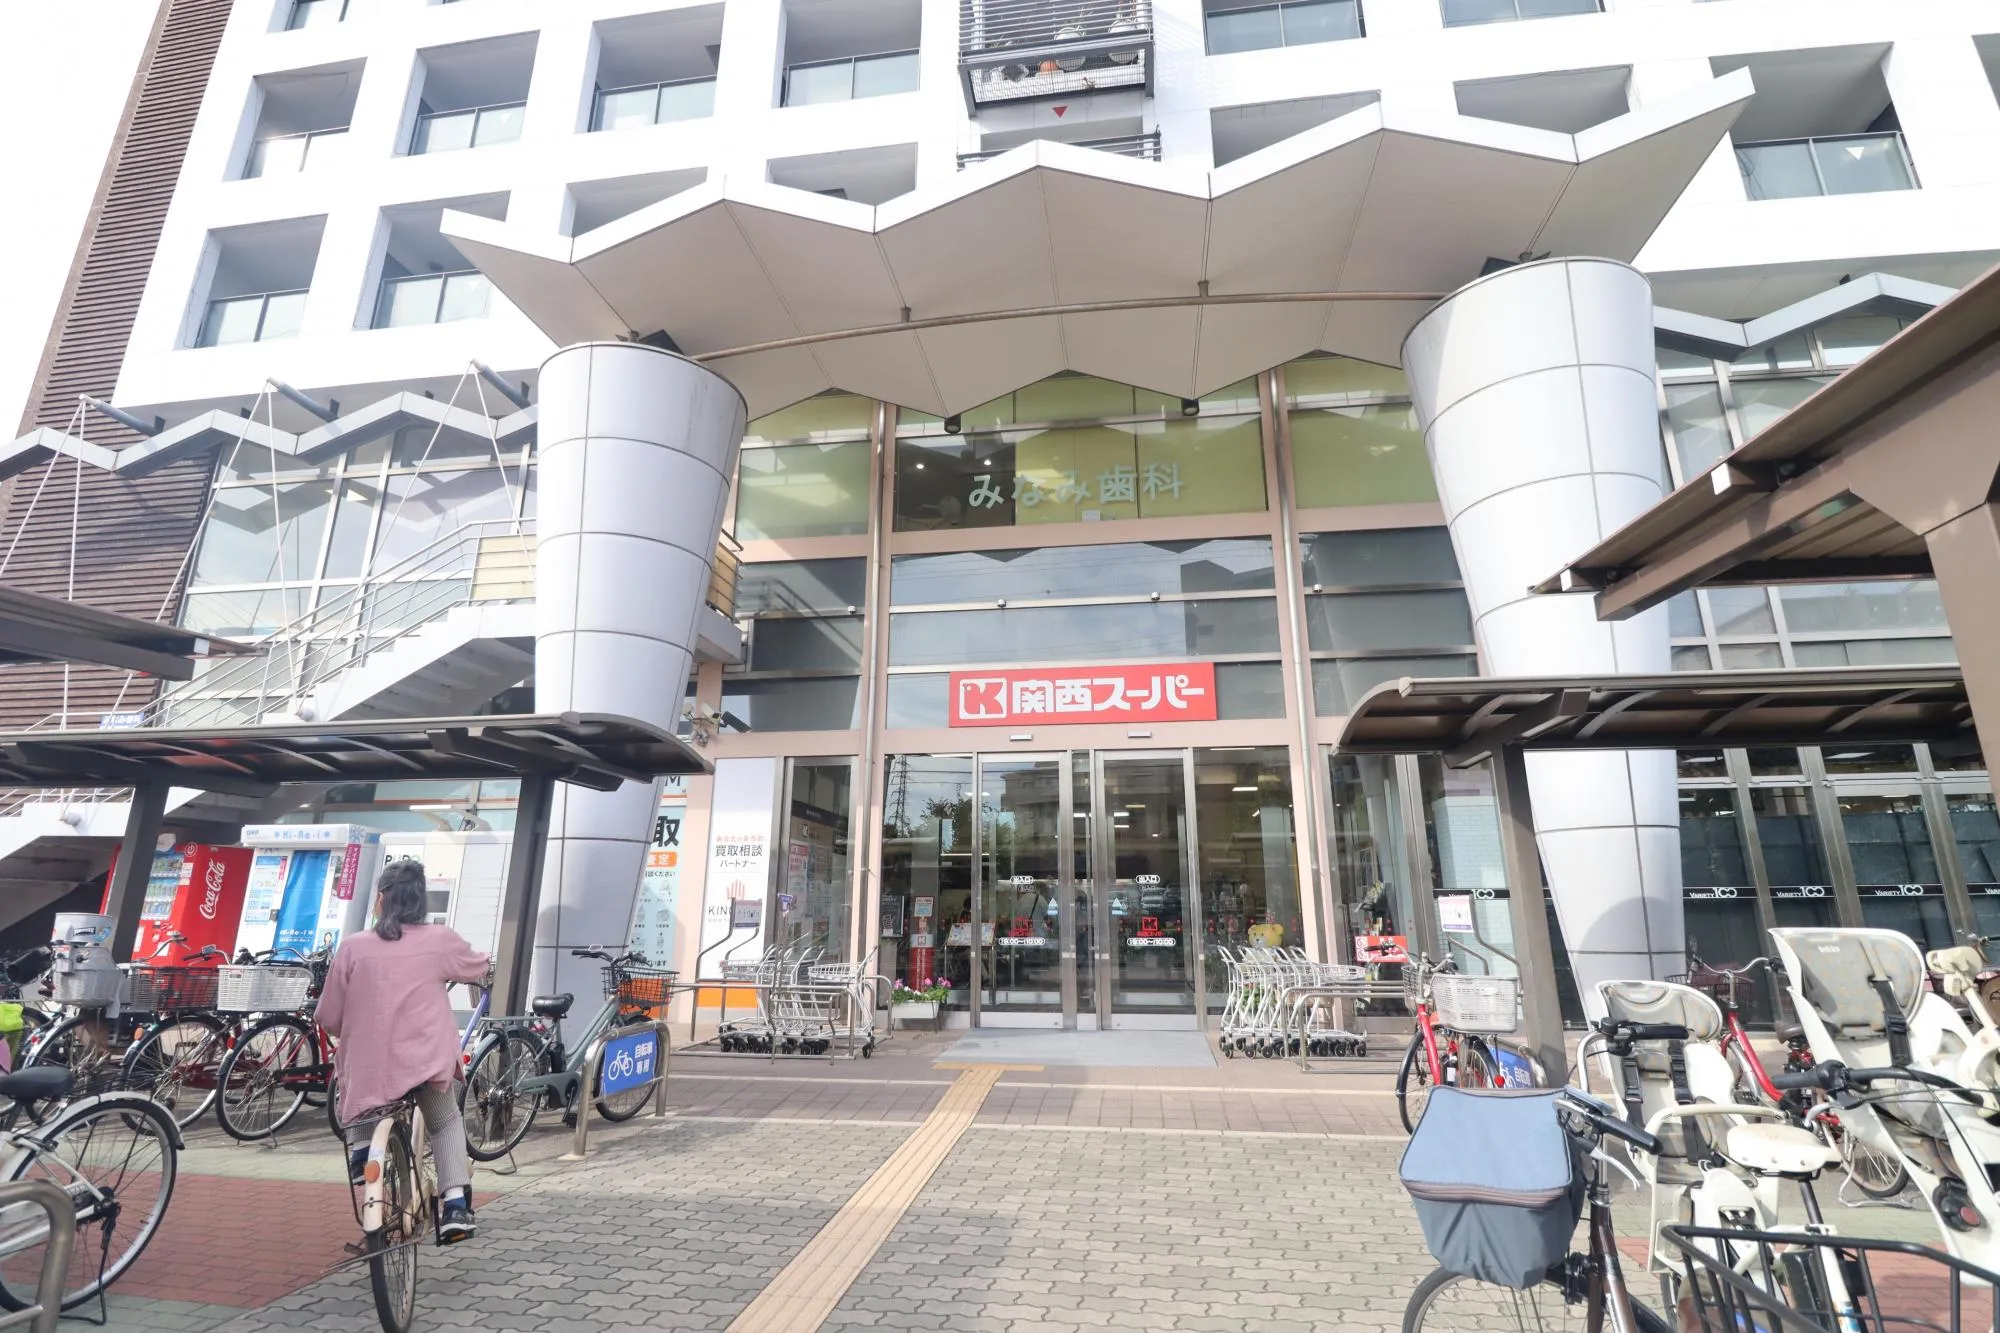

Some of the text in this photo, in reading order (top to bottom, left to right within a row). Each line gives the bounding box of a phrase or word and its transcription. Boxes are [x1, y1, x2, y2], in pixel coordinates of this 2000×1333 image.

[968, 462, 1183, 510] みなみ歯科
[1012, 674, 1205, 714] 関西スーパー
[715, 844, 763, 857] 買取相談
